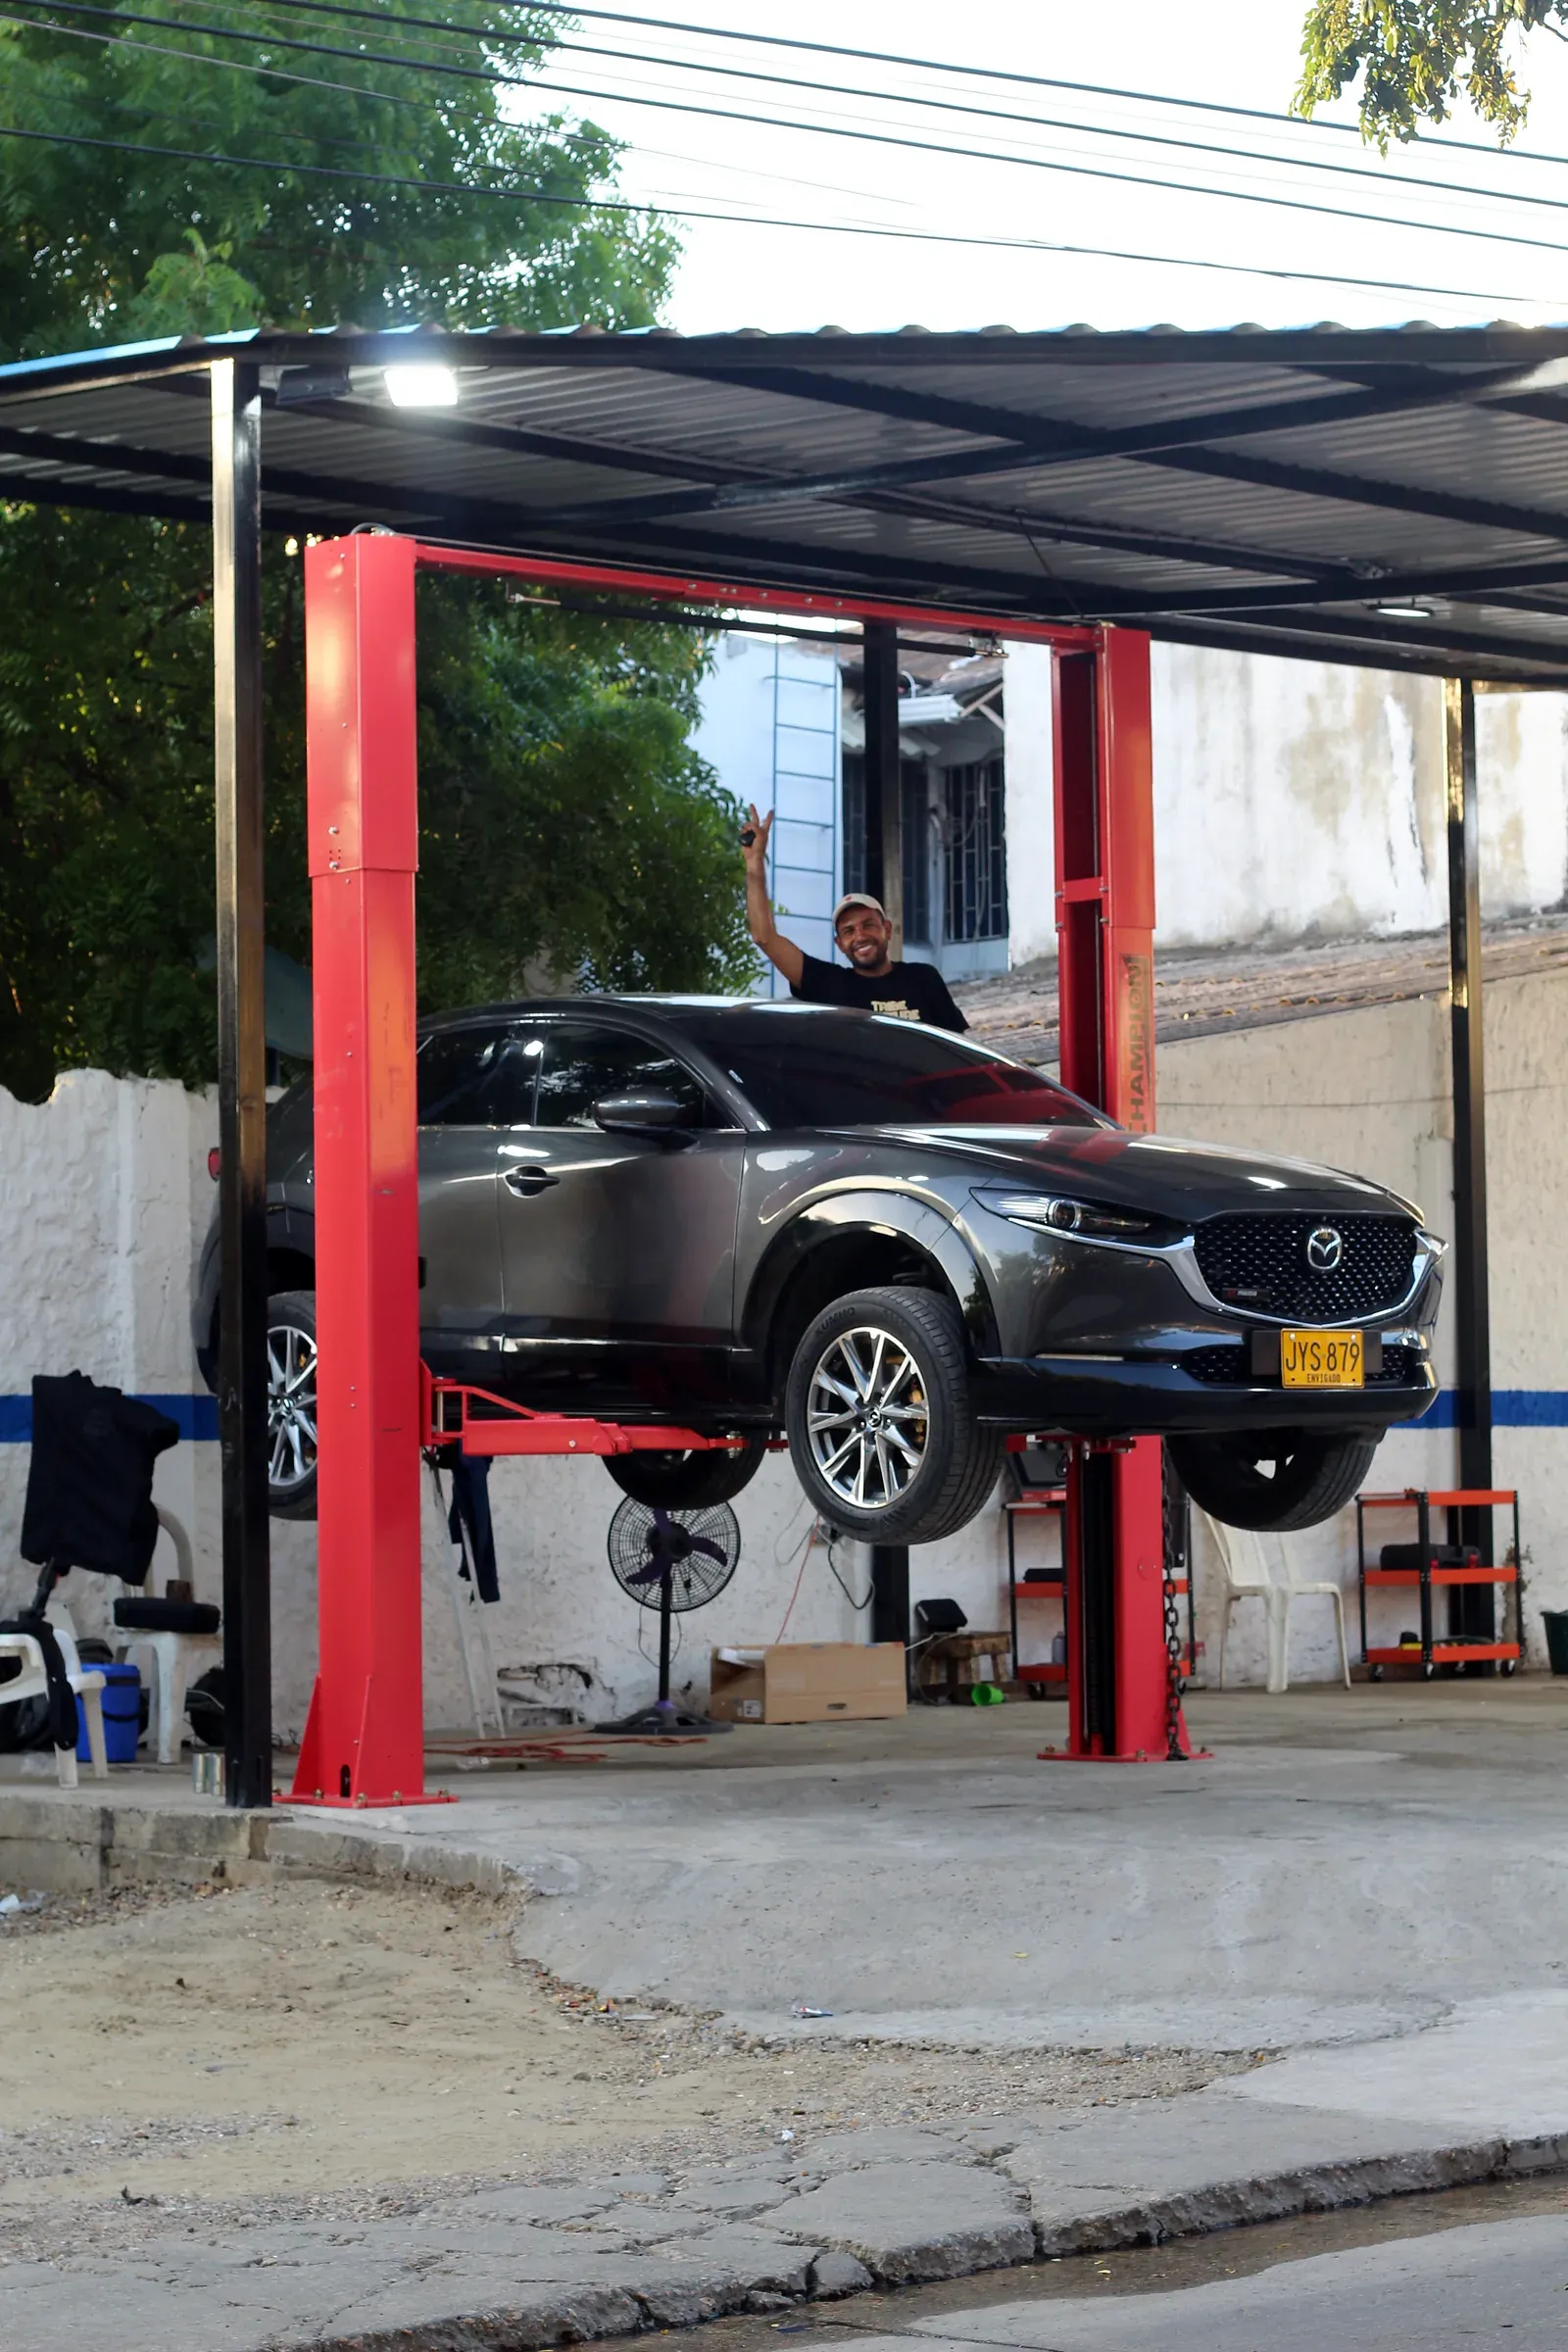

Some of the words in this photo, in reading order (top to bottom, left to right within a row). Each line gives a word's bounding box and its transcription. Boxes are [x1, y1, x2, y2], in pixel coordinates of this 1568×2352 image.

[1286, 1342, 1321, 1371] JYS
[1327, 1342, 1360, 1372] 879
[1306, 1373, 1341, 1384] ENVIGADO
